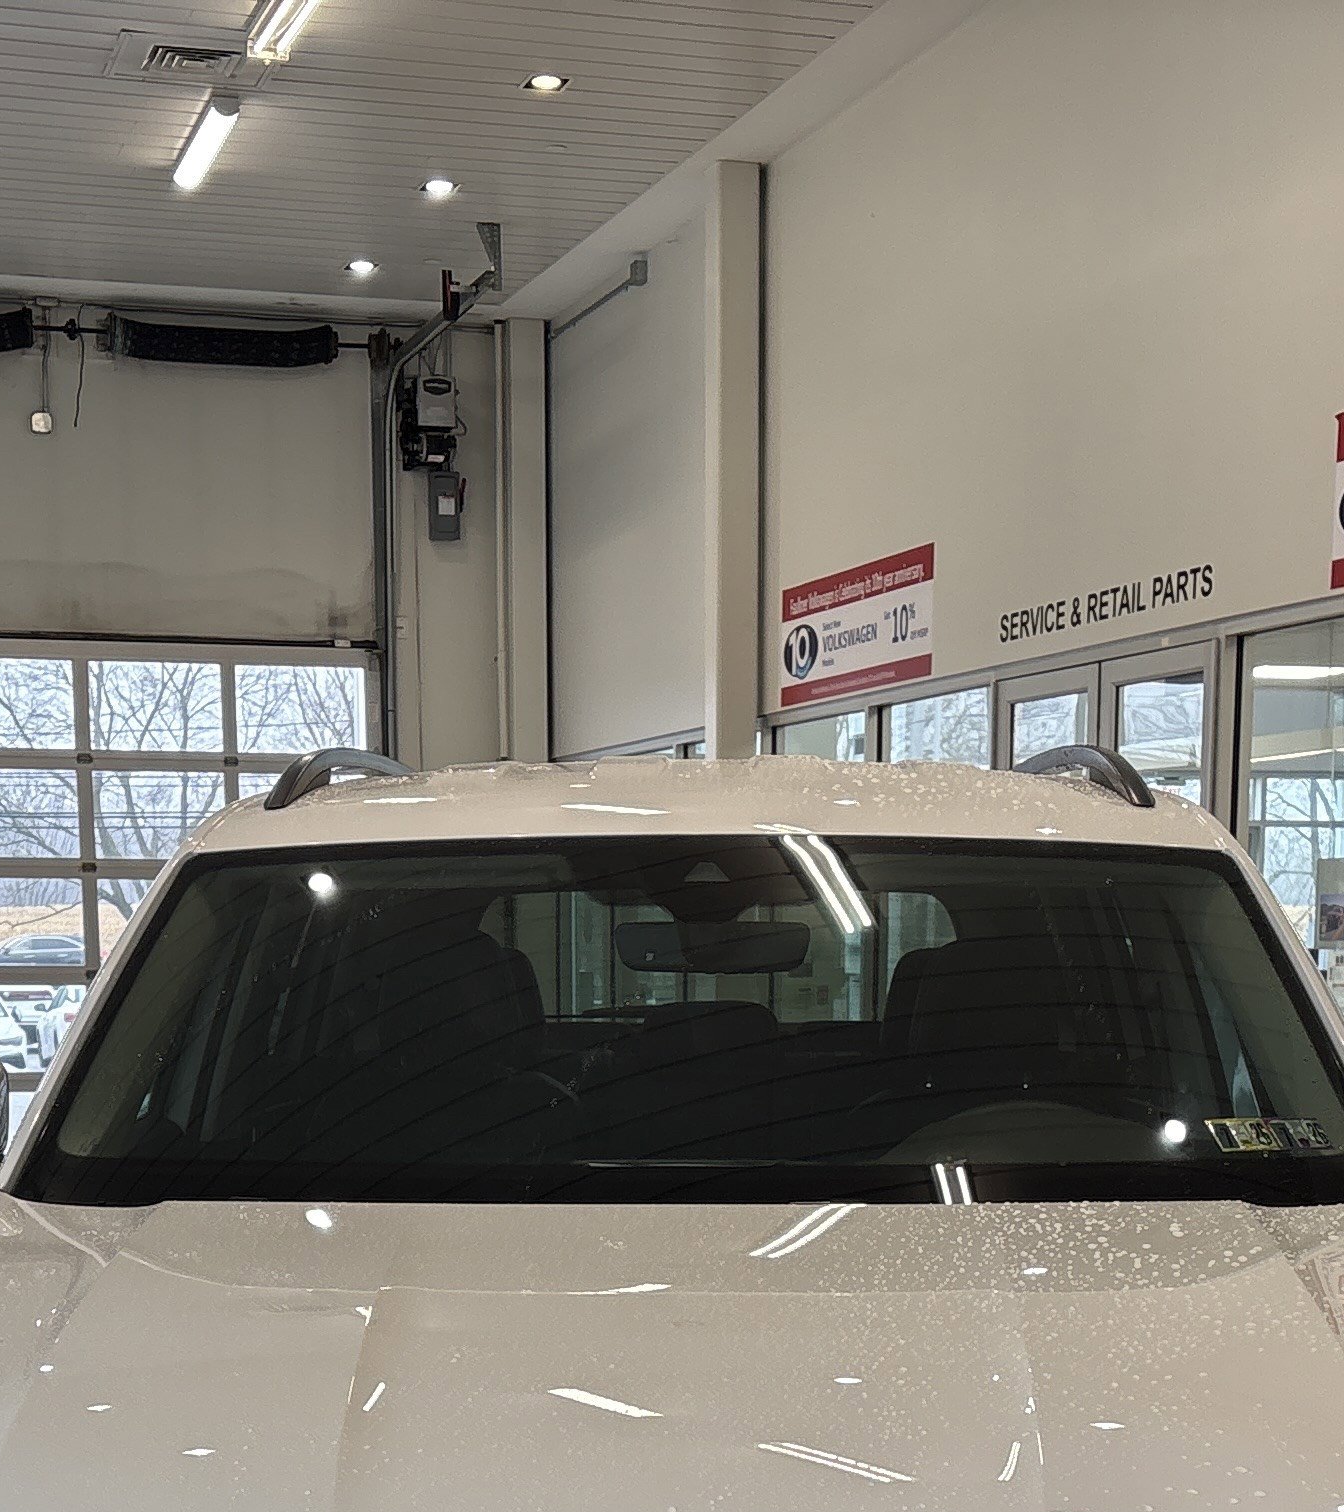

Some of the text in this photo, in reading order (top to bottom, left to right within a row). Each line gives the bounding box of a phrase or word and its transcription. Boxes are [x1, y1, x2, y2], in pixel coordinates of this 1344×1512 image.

[999, 564, 1214, 643] SERVICE & RETAIL PARTS
[822, 622, 878, 653] VOLKSWAGEN
